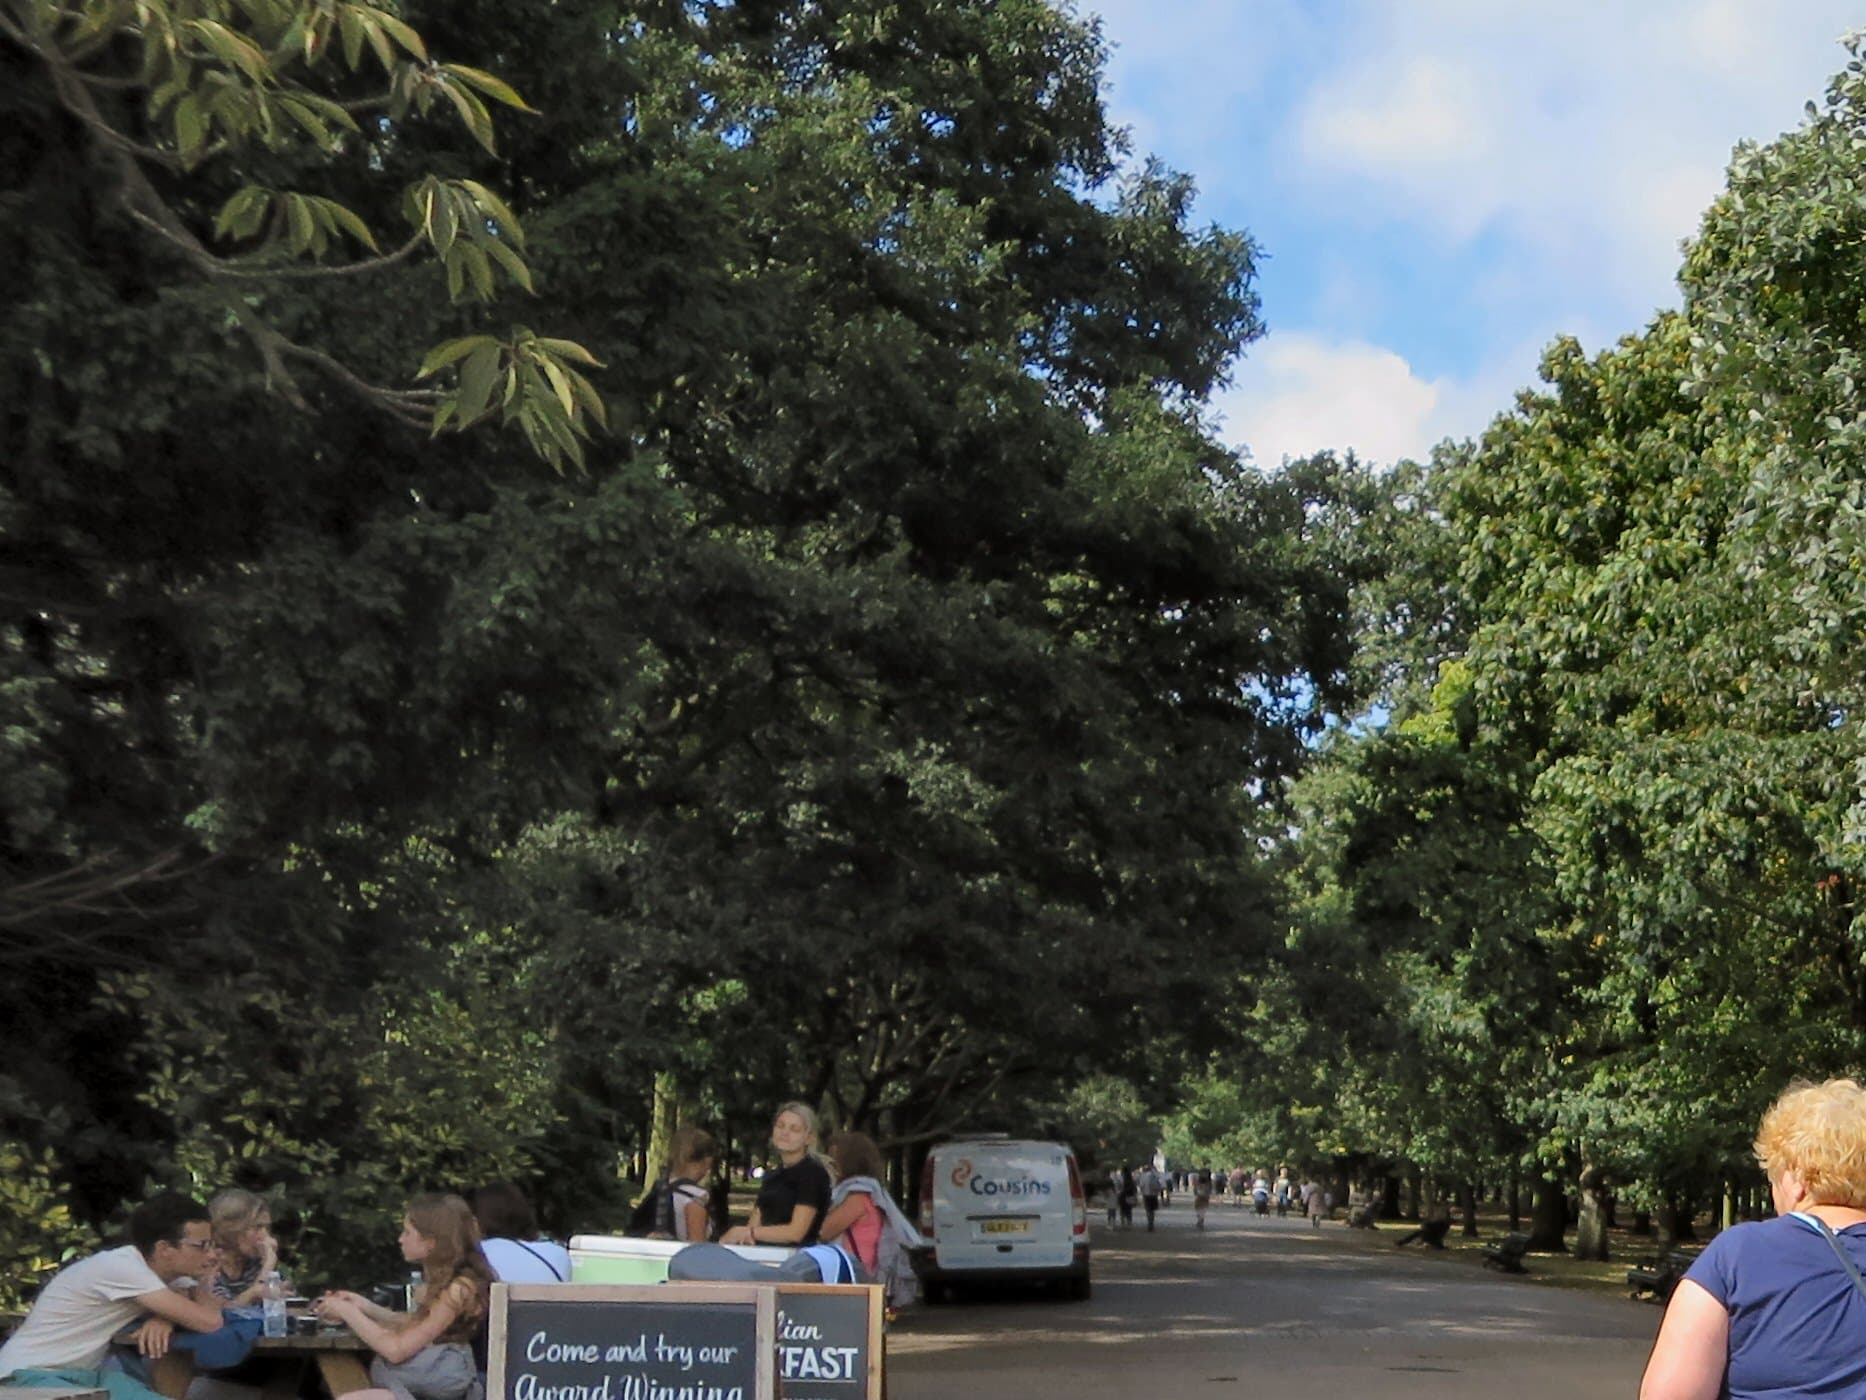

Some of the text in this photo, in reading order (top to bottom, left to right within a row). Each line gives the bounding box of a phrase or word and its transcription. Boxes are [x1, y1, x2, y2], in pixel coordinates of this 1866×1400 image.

[970, 1175, 1051, 1195] Cousins
[526, 1330, 739, 1371] Come and try our
[779, 1346, 859, 1379] FAST
